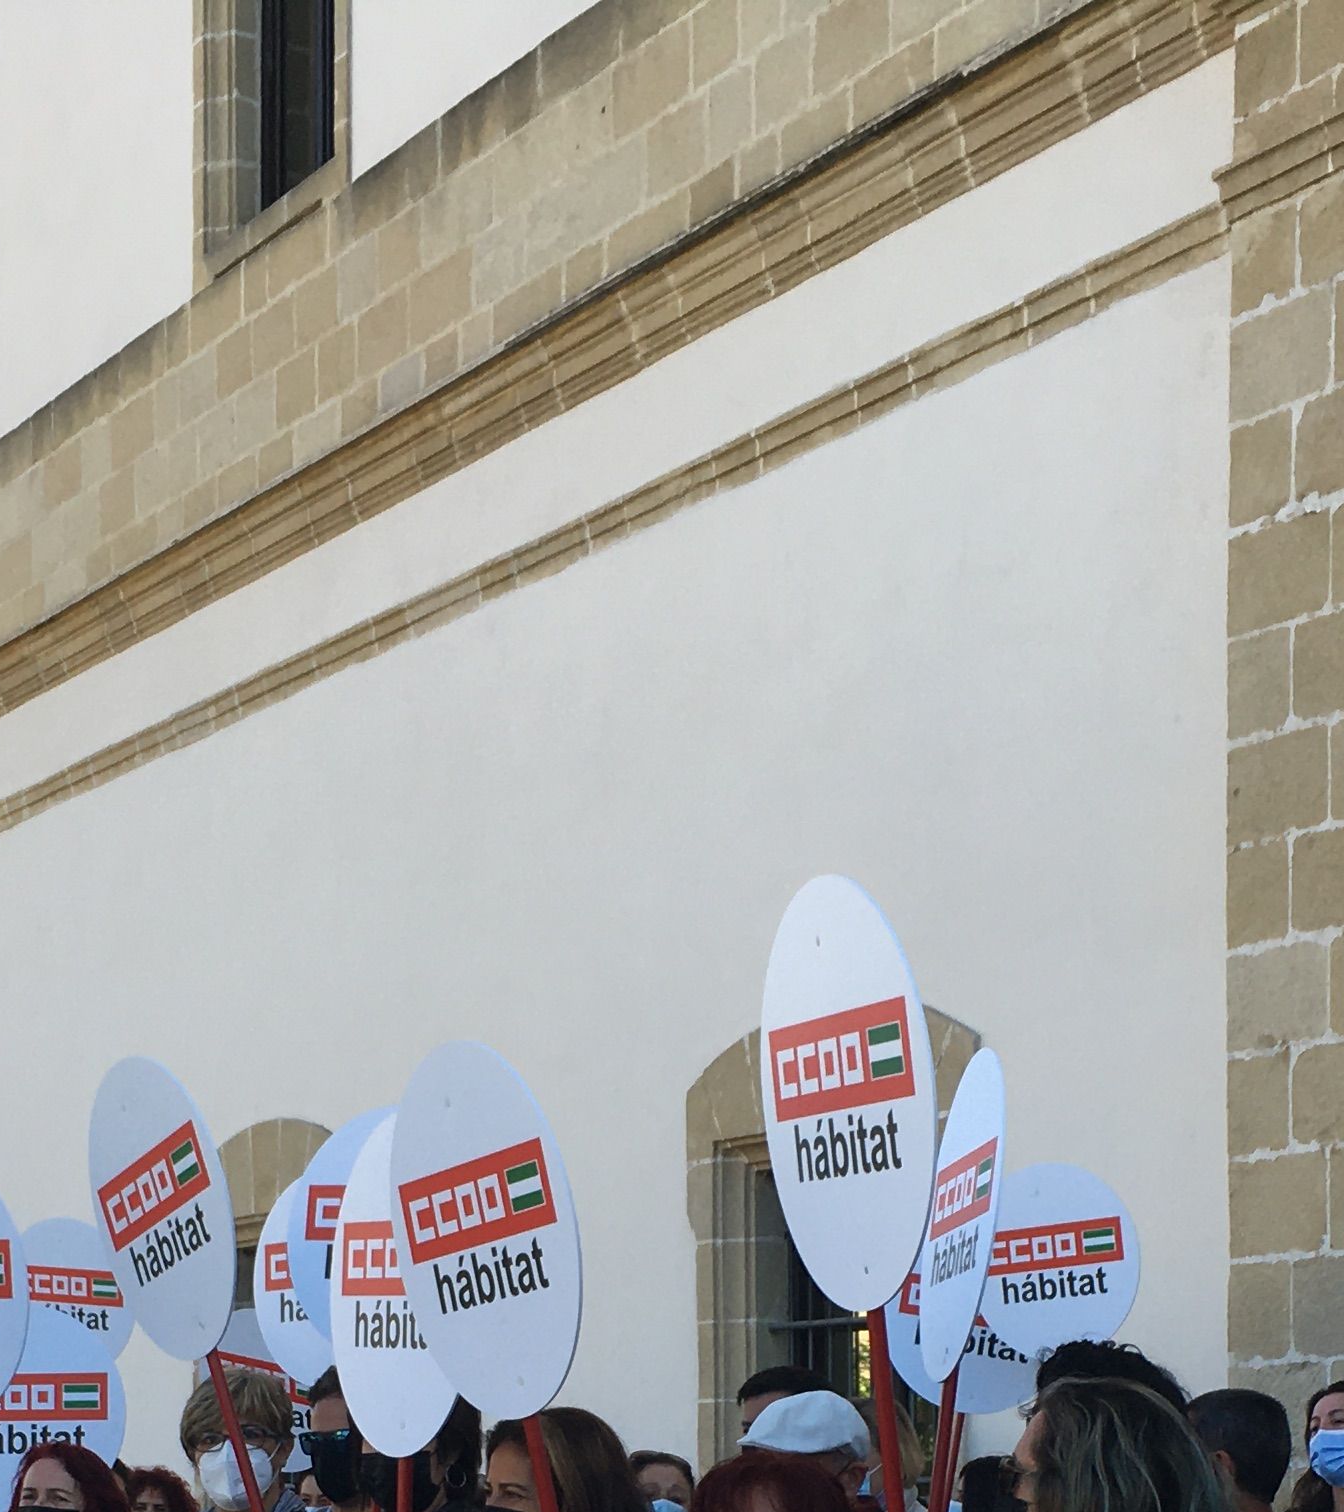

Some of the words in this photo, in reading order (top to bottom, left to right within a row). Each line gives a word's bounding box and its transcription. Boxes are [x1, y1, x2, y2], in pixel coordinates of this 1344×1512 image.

[776, 1031, 864, 1100] CCOO
[794, 1109, 902, 1183] hábitat
[107, 1160, 173, 1234] CCOO
[409, 1174, 506, 1243] CCOO
[934, 1166, 977, 1224] CCOO
[130, 1202, 212, 1287] hábitat
[433, 1236, 549, 1314] hábitat
[931, 1224, 979, 1288] hábitat
[28, 1273, 87, 1297] COO
[1001, 1267, 1108, 1305] hábitat
[355, 1300, 427, 1349] hábit
